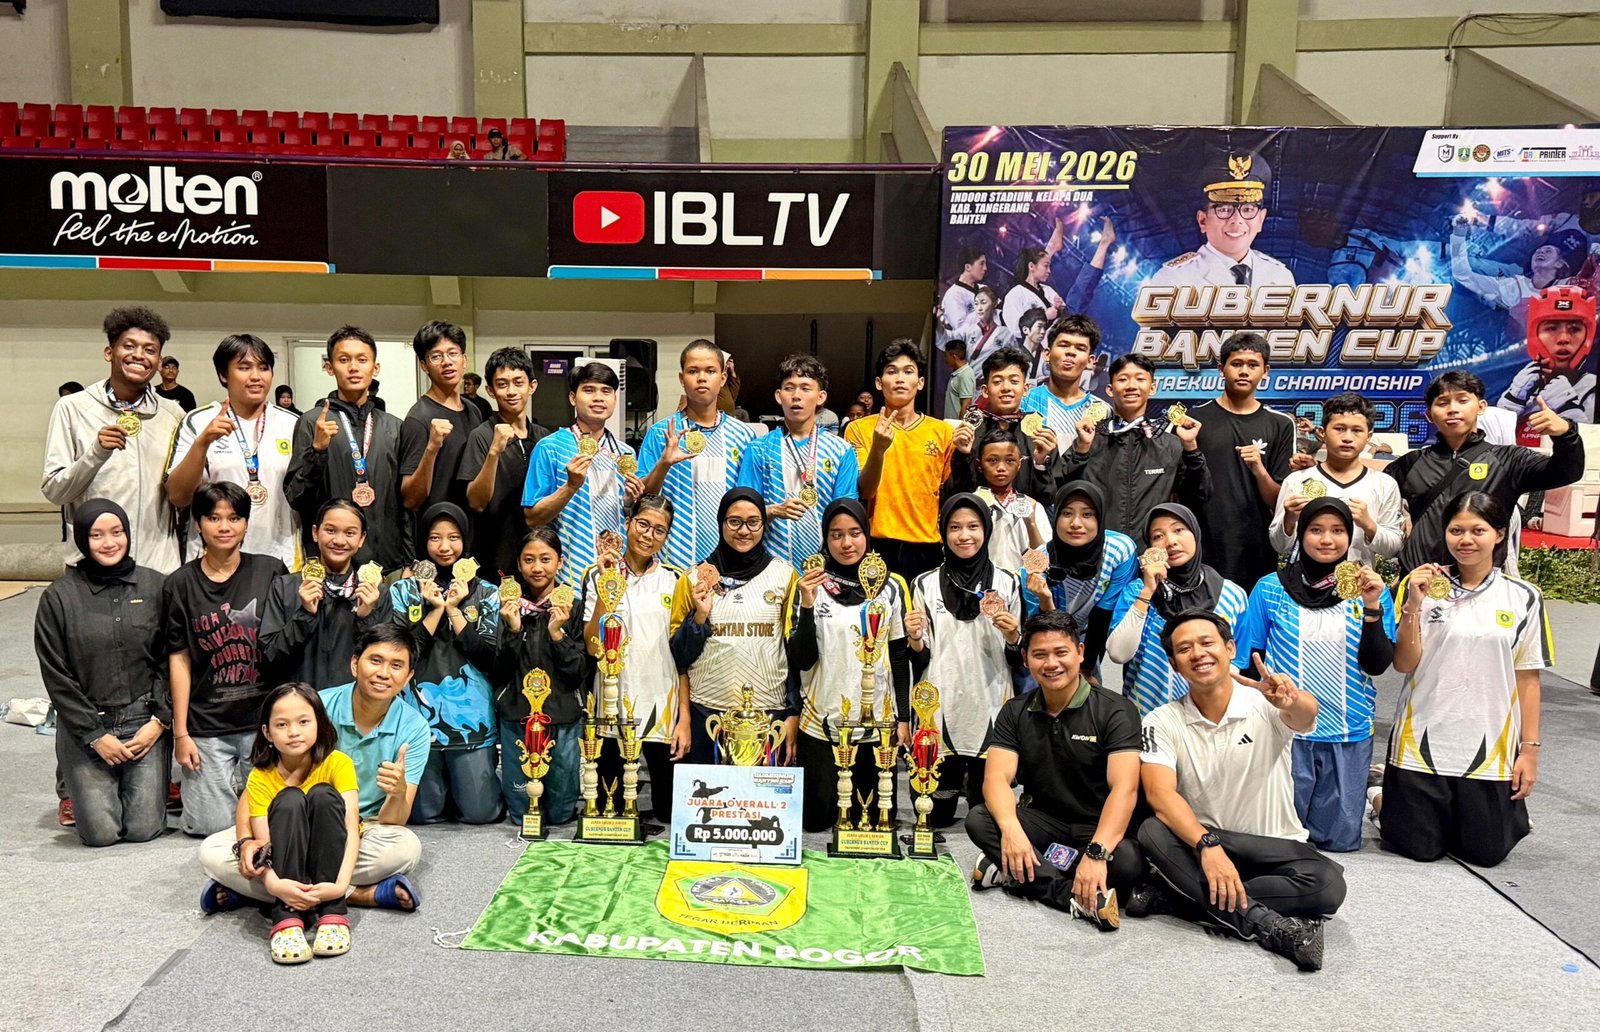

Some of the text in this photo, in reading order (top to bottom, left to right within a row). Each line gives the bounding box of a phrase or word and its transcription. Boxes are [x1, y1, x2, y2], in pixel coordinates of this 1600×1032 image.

[948, 150, 1138, 182] 30 MEI 2026
[950, 192, 1093, 203] INDOOR STADIUM, KELAPA DUA
[950, 203, 1030, 214] KAB. TANGERANG
[950, 214, 987, 225] BANTEN
[53, 212, 112, 247] feel
[110, 220, 155, 245] the
[1131, 283, 1453, 329] GUBERNUR
[1339, 329, 1448, 364] CUP
[1154, 375, 1424, 391] TAEKWOO CHAMPIONSHIP
[711, 622, 774, 637] PARTAN STORE
[687, 798, 723, 807] JUARA
[728, 799, 776, 809] OVERALL
[712, 810, 761, 820] PRESTASI
[694, 827, 776, 842] Rp 5.000.000
[526, 929, 924, 964] KABUPATEN BOGOR
